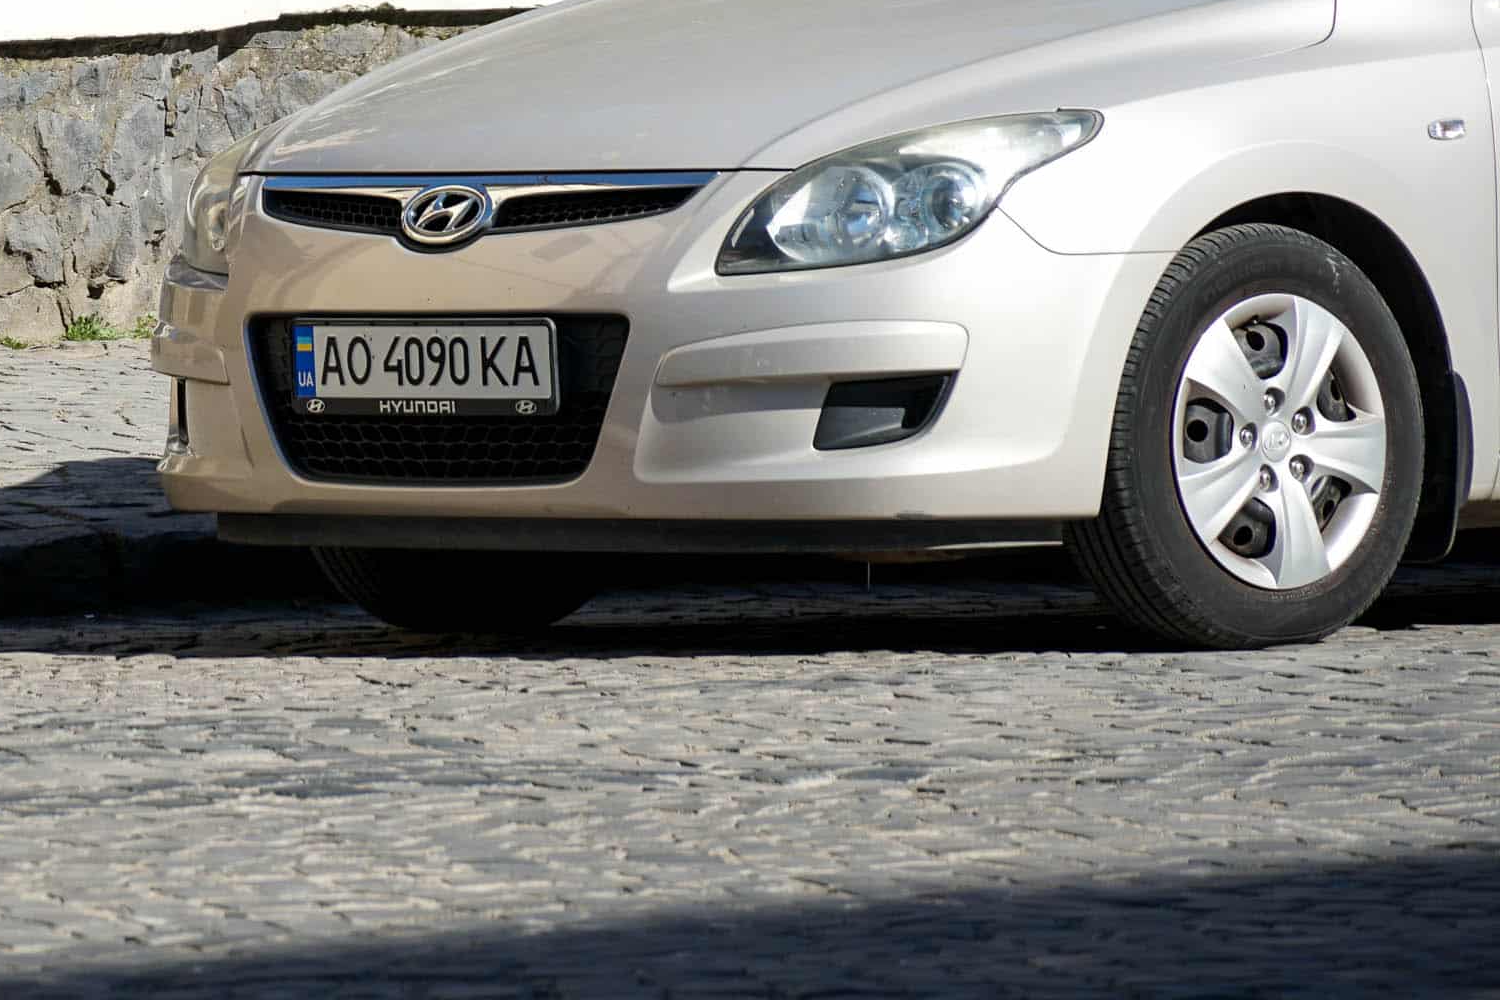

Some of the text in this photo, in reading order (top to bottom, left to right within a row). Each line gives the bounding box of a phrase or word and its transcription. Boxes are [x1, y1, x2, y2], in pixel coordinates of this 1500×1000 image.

[321, 336, 540, 387] AO 4090 KA
[298, 371, 314, 387] UA
[379, 400, 456, 414] HYUNDAI
